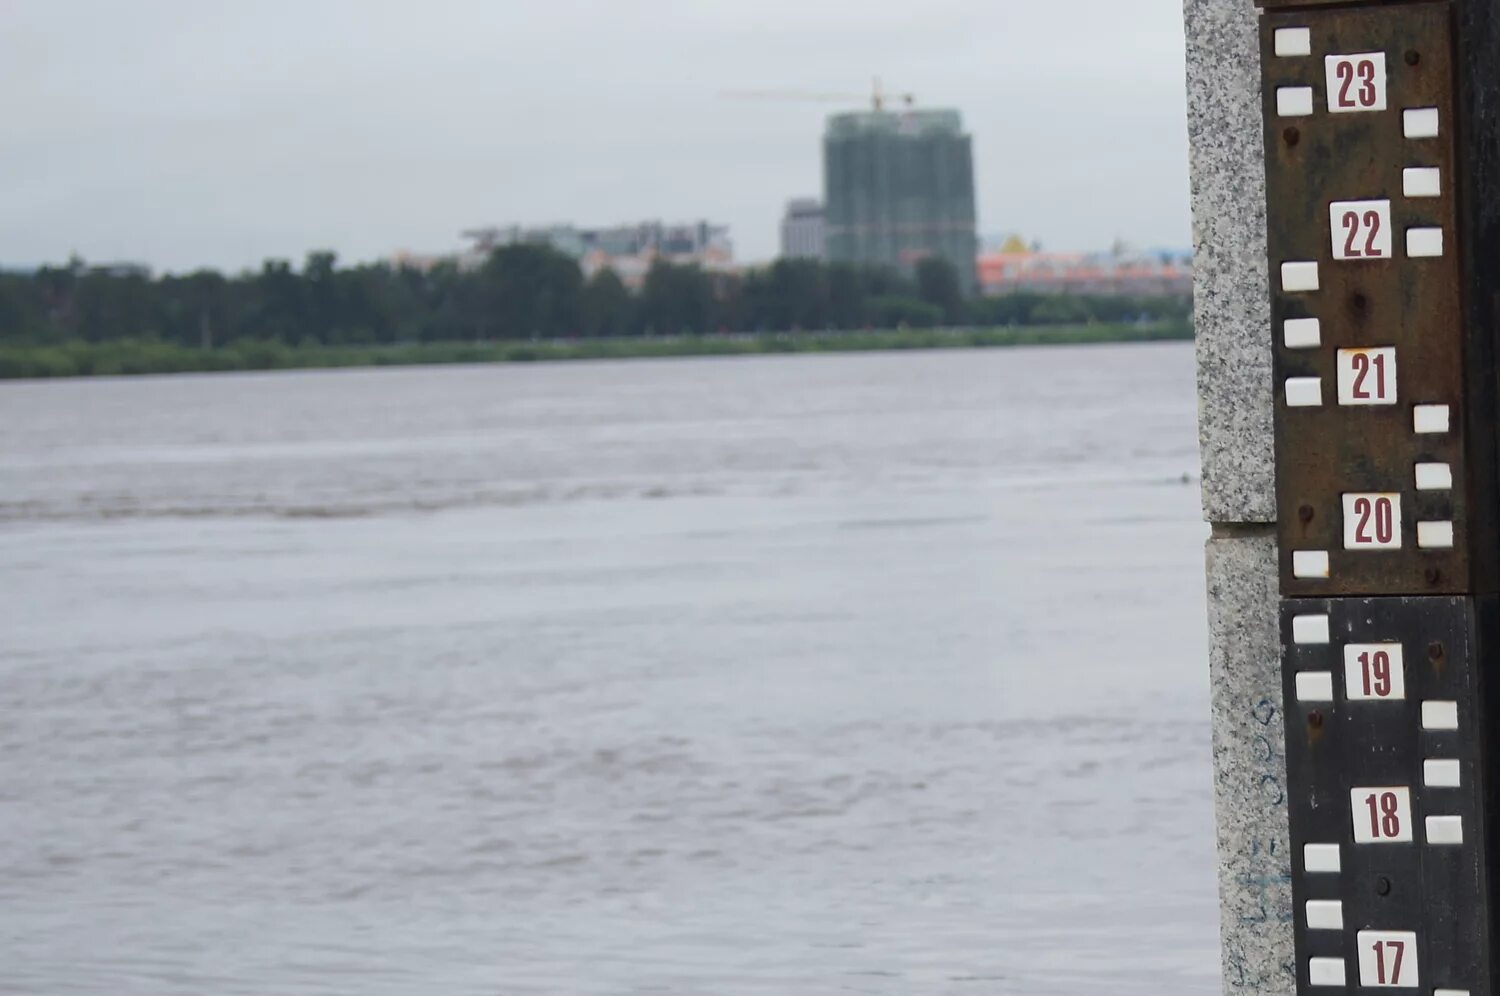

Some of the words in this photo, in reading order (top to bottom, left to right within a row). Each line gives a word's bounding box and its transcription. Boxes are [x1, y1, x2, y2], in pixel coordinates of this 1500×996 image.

[1337, 60, 1376, 108] 23
[1342, 211, 1381, 255] 22
[1351, 352, 1384, 399] 21
[1354, 497, 1393, 544] 20
[1357, 651, 1391, 696] 19
[1366, 791, 1399, 838] 18
[1372, 941, 1405, 984] 17
